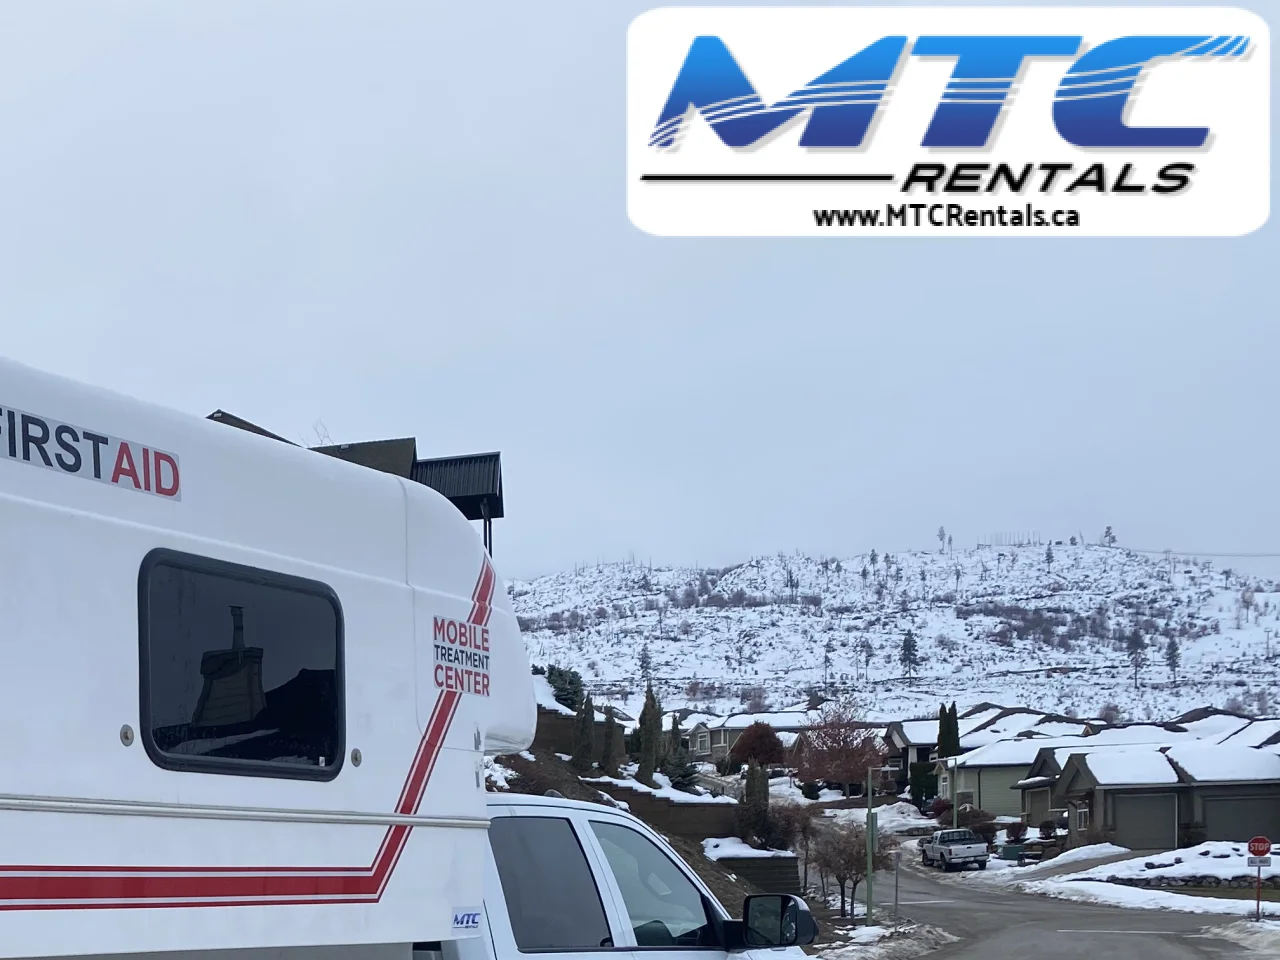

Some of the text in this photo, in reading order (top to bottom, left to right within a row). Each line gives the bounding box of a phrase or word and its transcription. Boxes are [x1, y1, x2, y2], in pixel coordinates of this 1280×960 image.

[433, 617, 489, 652] MOBILE
[434, 644, 490, 671] TREATMENT
[434, 663, 490, 697] CENTER
[1250, 843, 1269, 851] STOP
[453, 912, 481, 925] MTC
